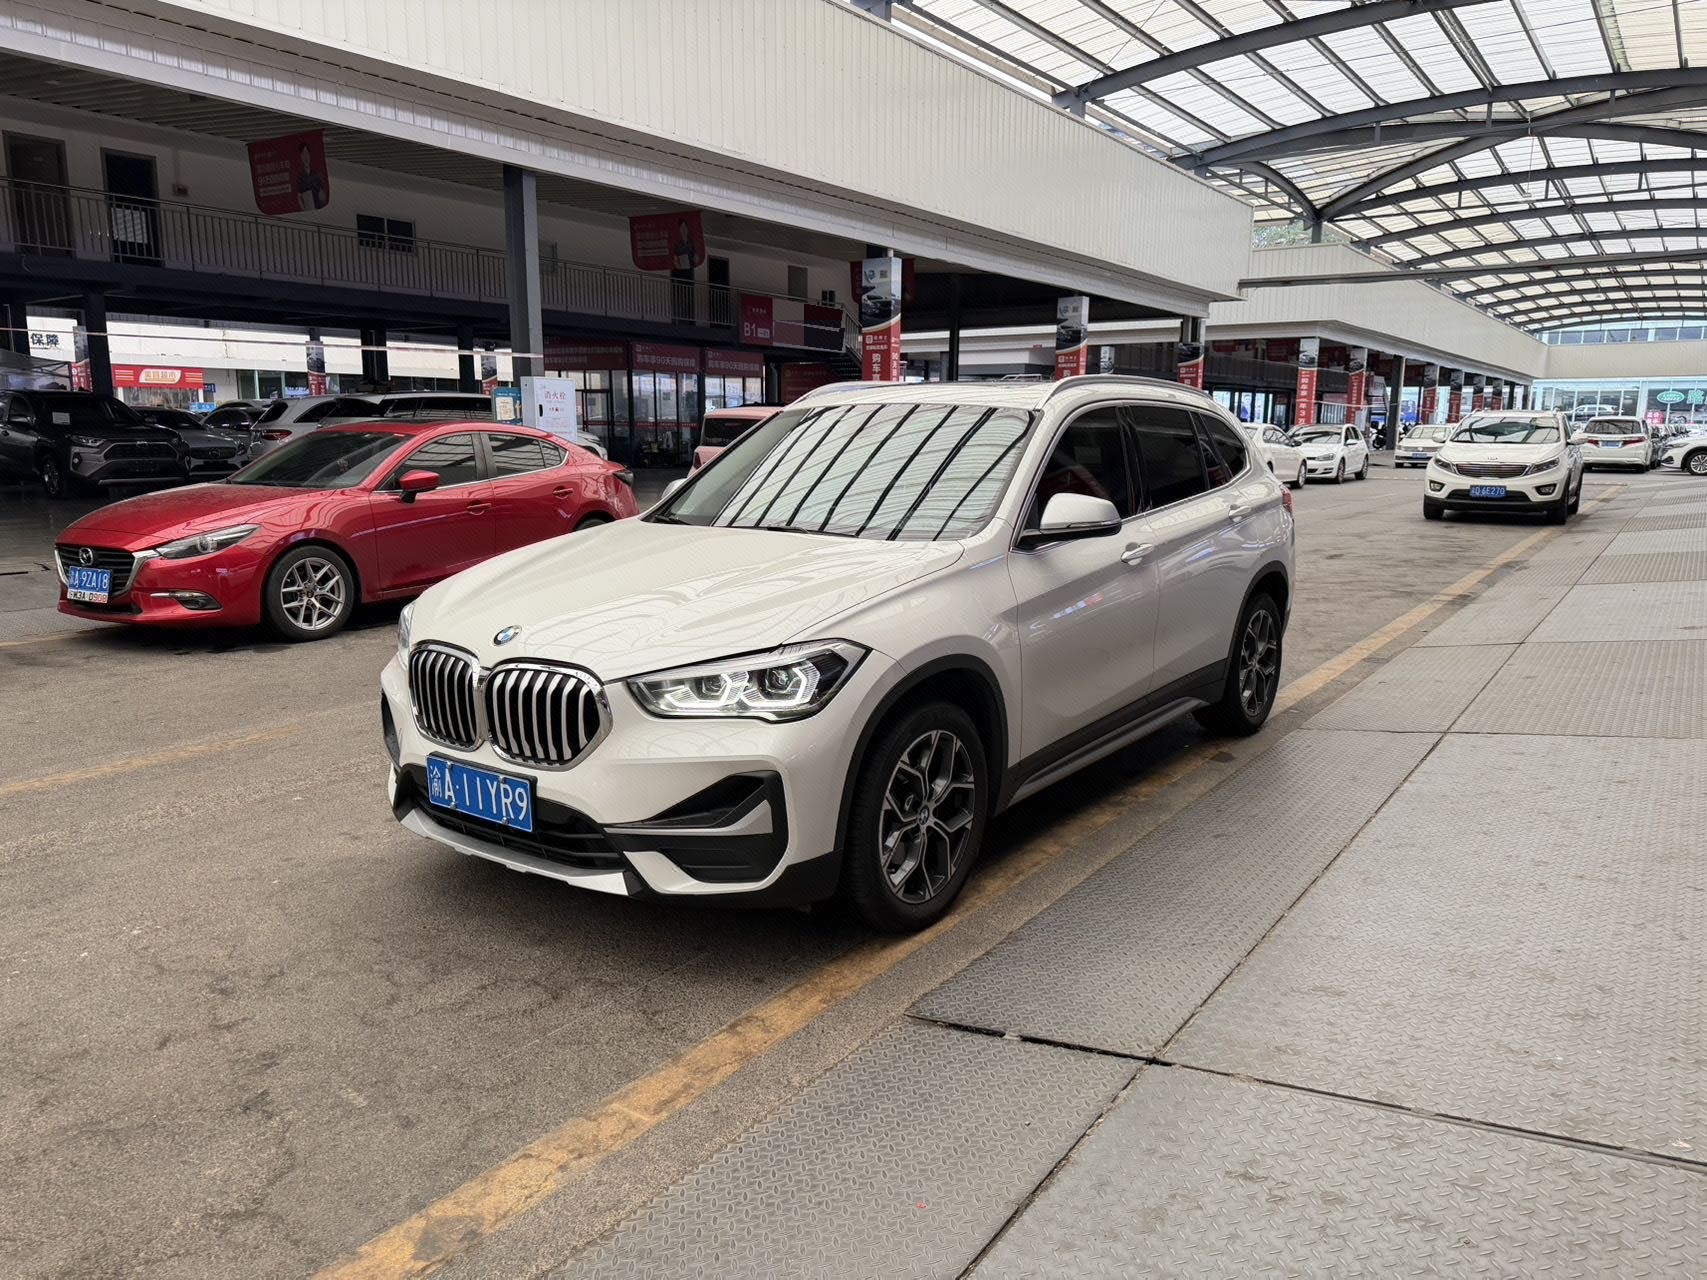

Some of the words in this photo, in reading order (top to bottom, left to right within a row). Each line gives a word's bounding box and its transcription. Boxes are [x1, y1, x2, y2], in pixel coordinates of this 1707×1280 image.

[31, 333, 59, 346] 保障
[544, 391, 566, 401] 消火栓
